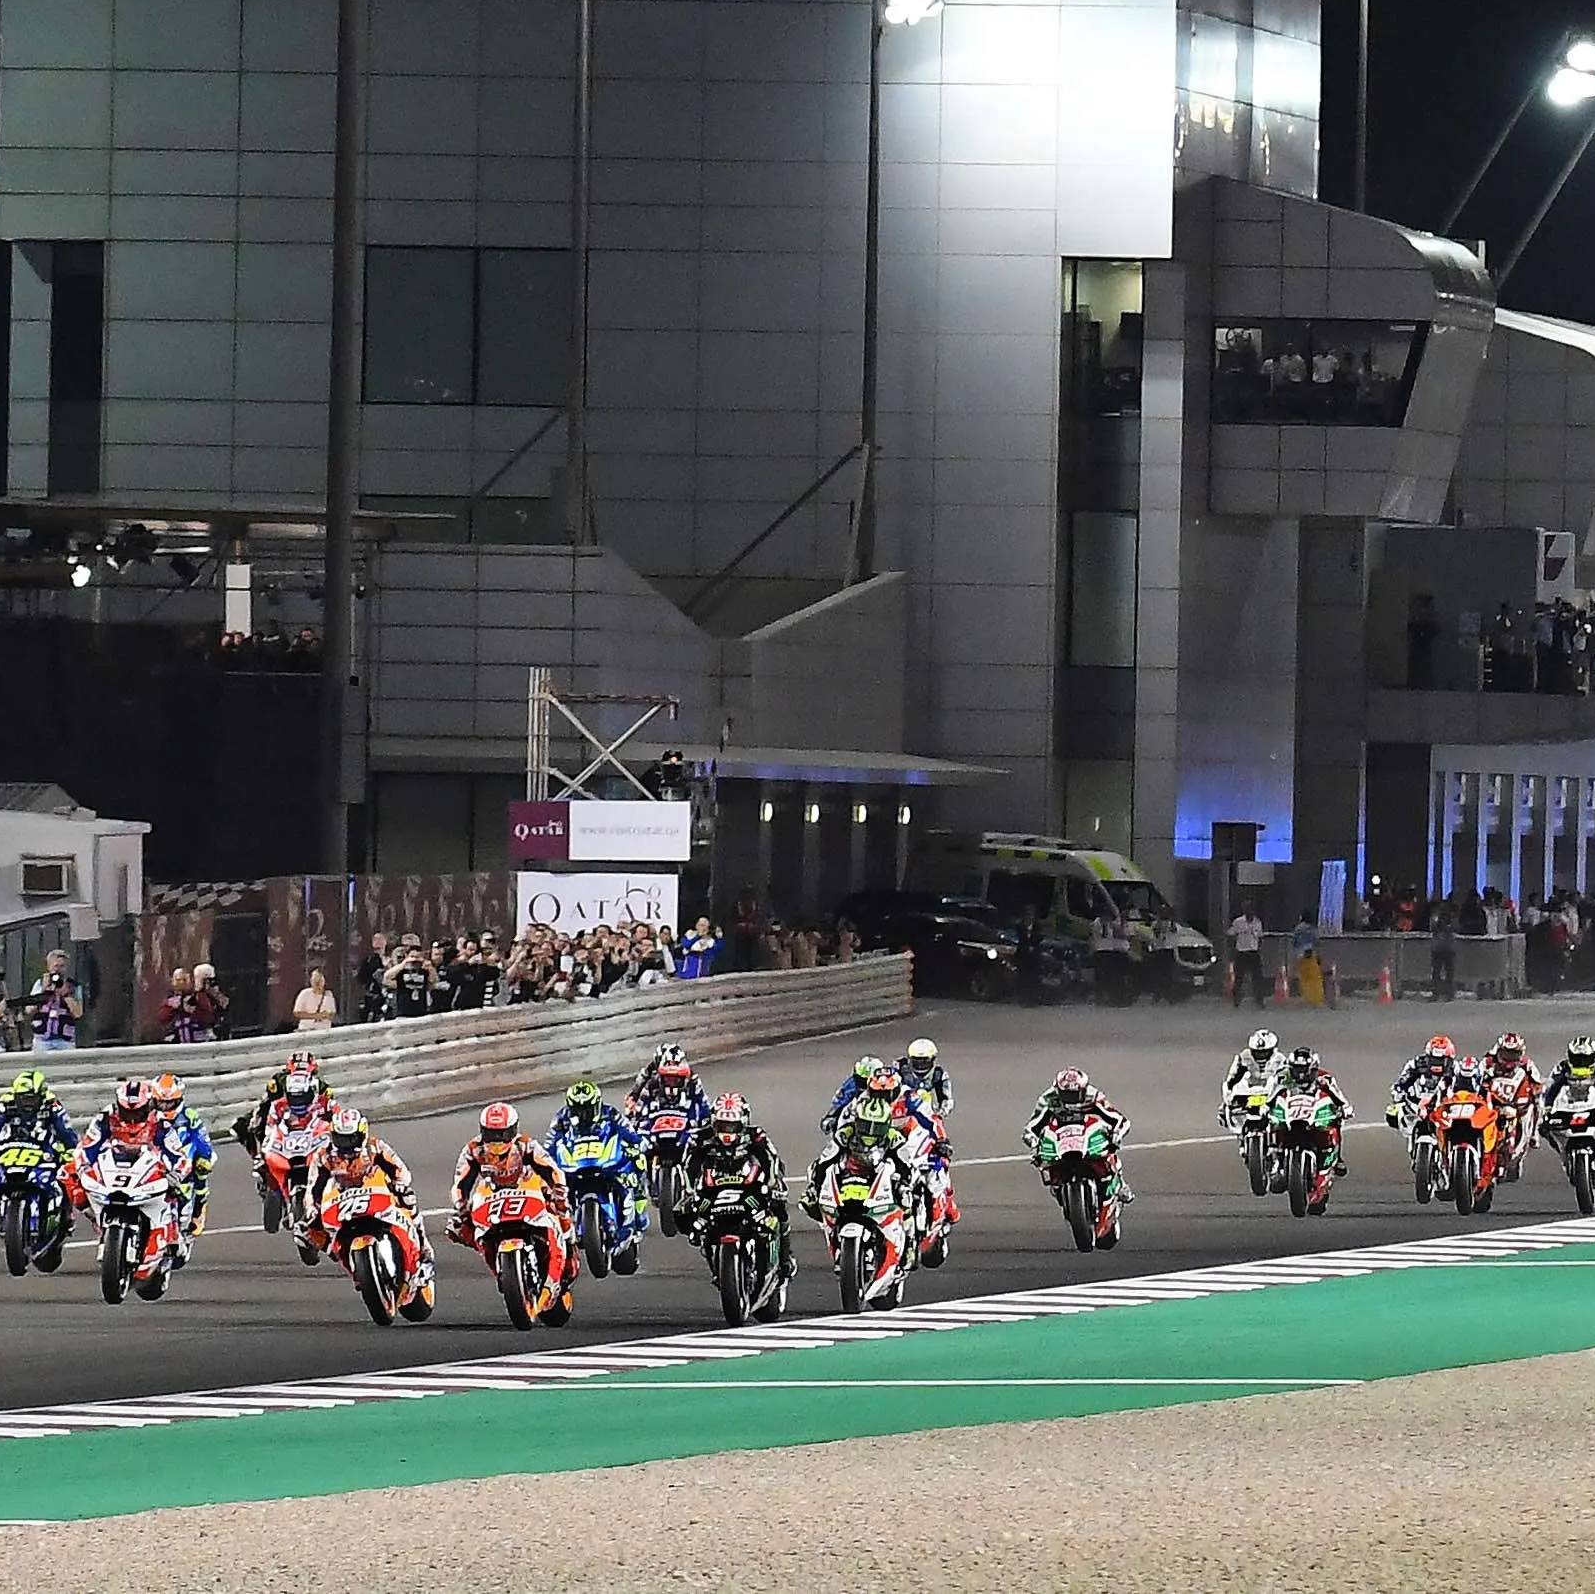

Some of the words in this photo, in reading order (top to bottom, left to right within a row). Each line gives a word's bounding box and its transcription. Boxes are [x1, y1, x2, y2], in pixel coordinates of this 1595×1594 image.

[514, 821, 564, 841] QATAR
[528, 888, 662, 925] QATAR
[574, 1142, 605, 1158] 29
[112, 1175, 132, 1187] 9
[487, 1198, 526, 1224] 93
